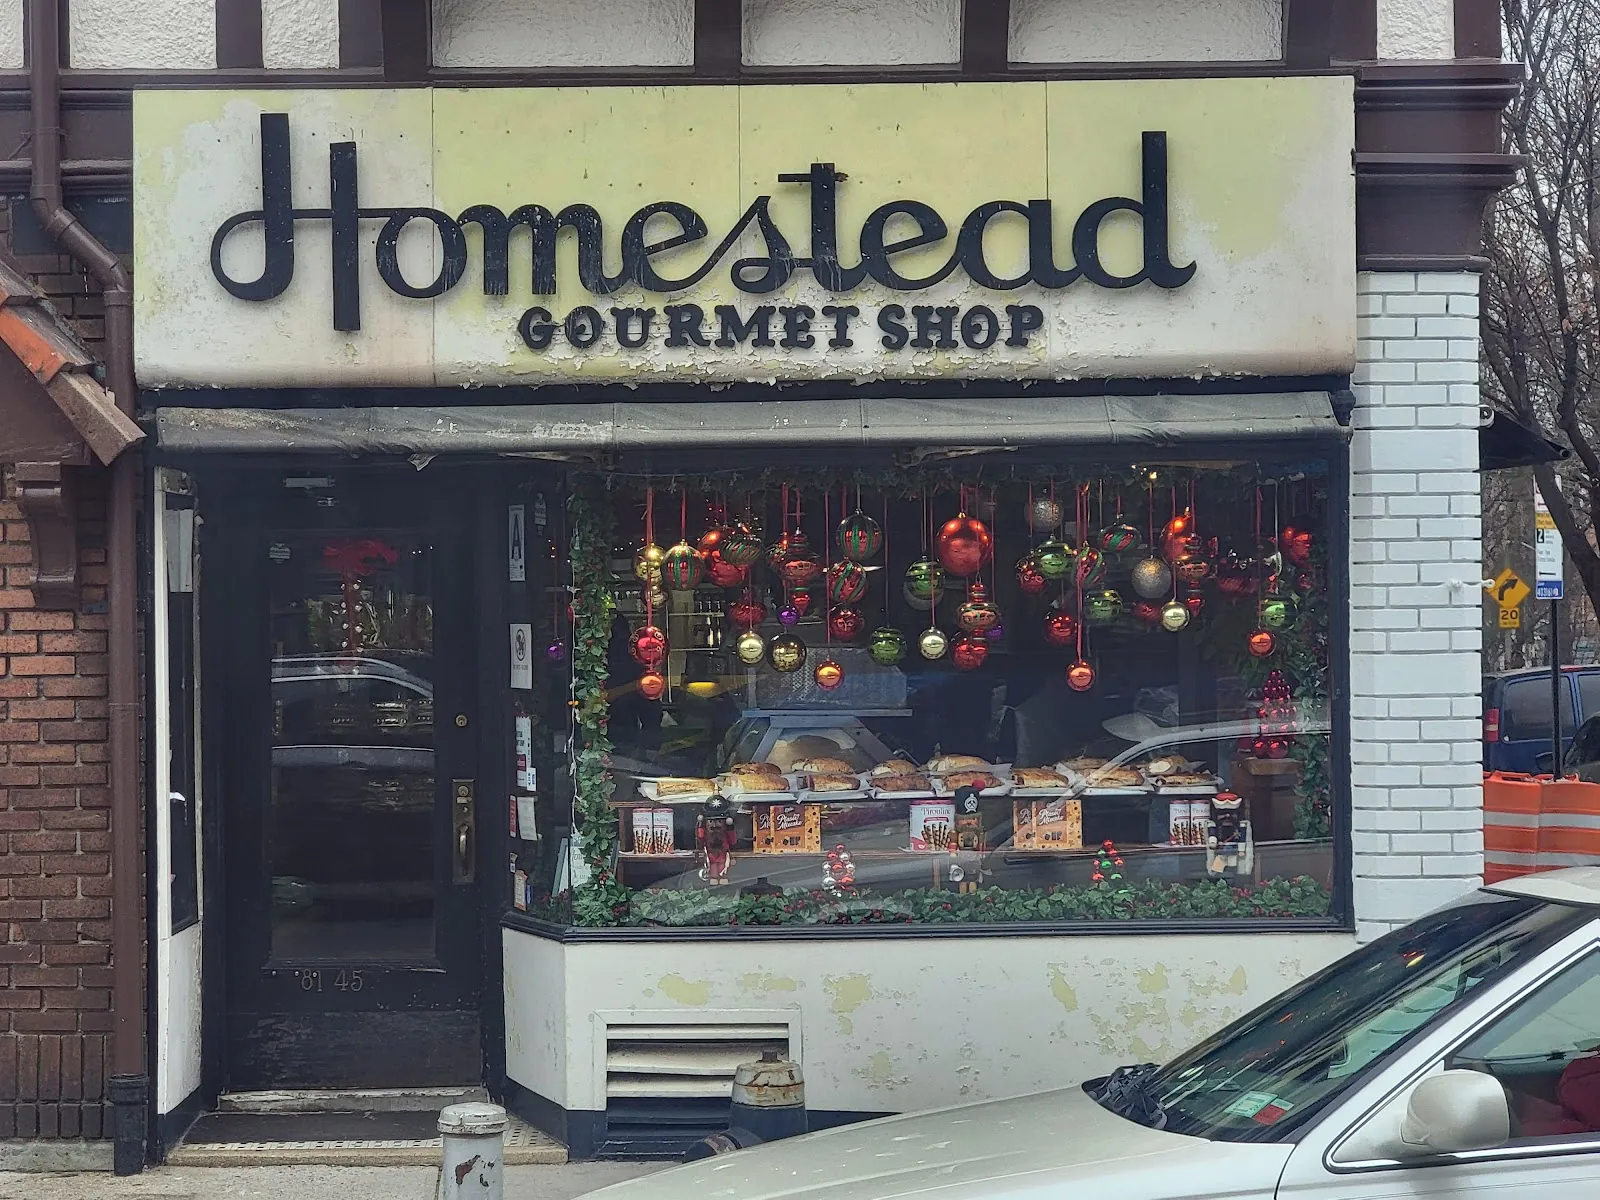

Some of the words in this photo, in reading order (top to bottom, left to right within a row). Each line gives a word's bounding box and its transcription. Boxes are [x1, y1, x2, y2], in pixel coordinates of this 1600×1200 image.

[210, 112, 1197, 331] Homestead
[518, 304, 860, 350] GOURMET
[877, 303, 1044, 350] SHOP
[511, 513, 522, 559] A
[1500, 609, 1518, 620] 20
[301, 968, 323, 992] 81
[333, 969, 365, 992] 45
